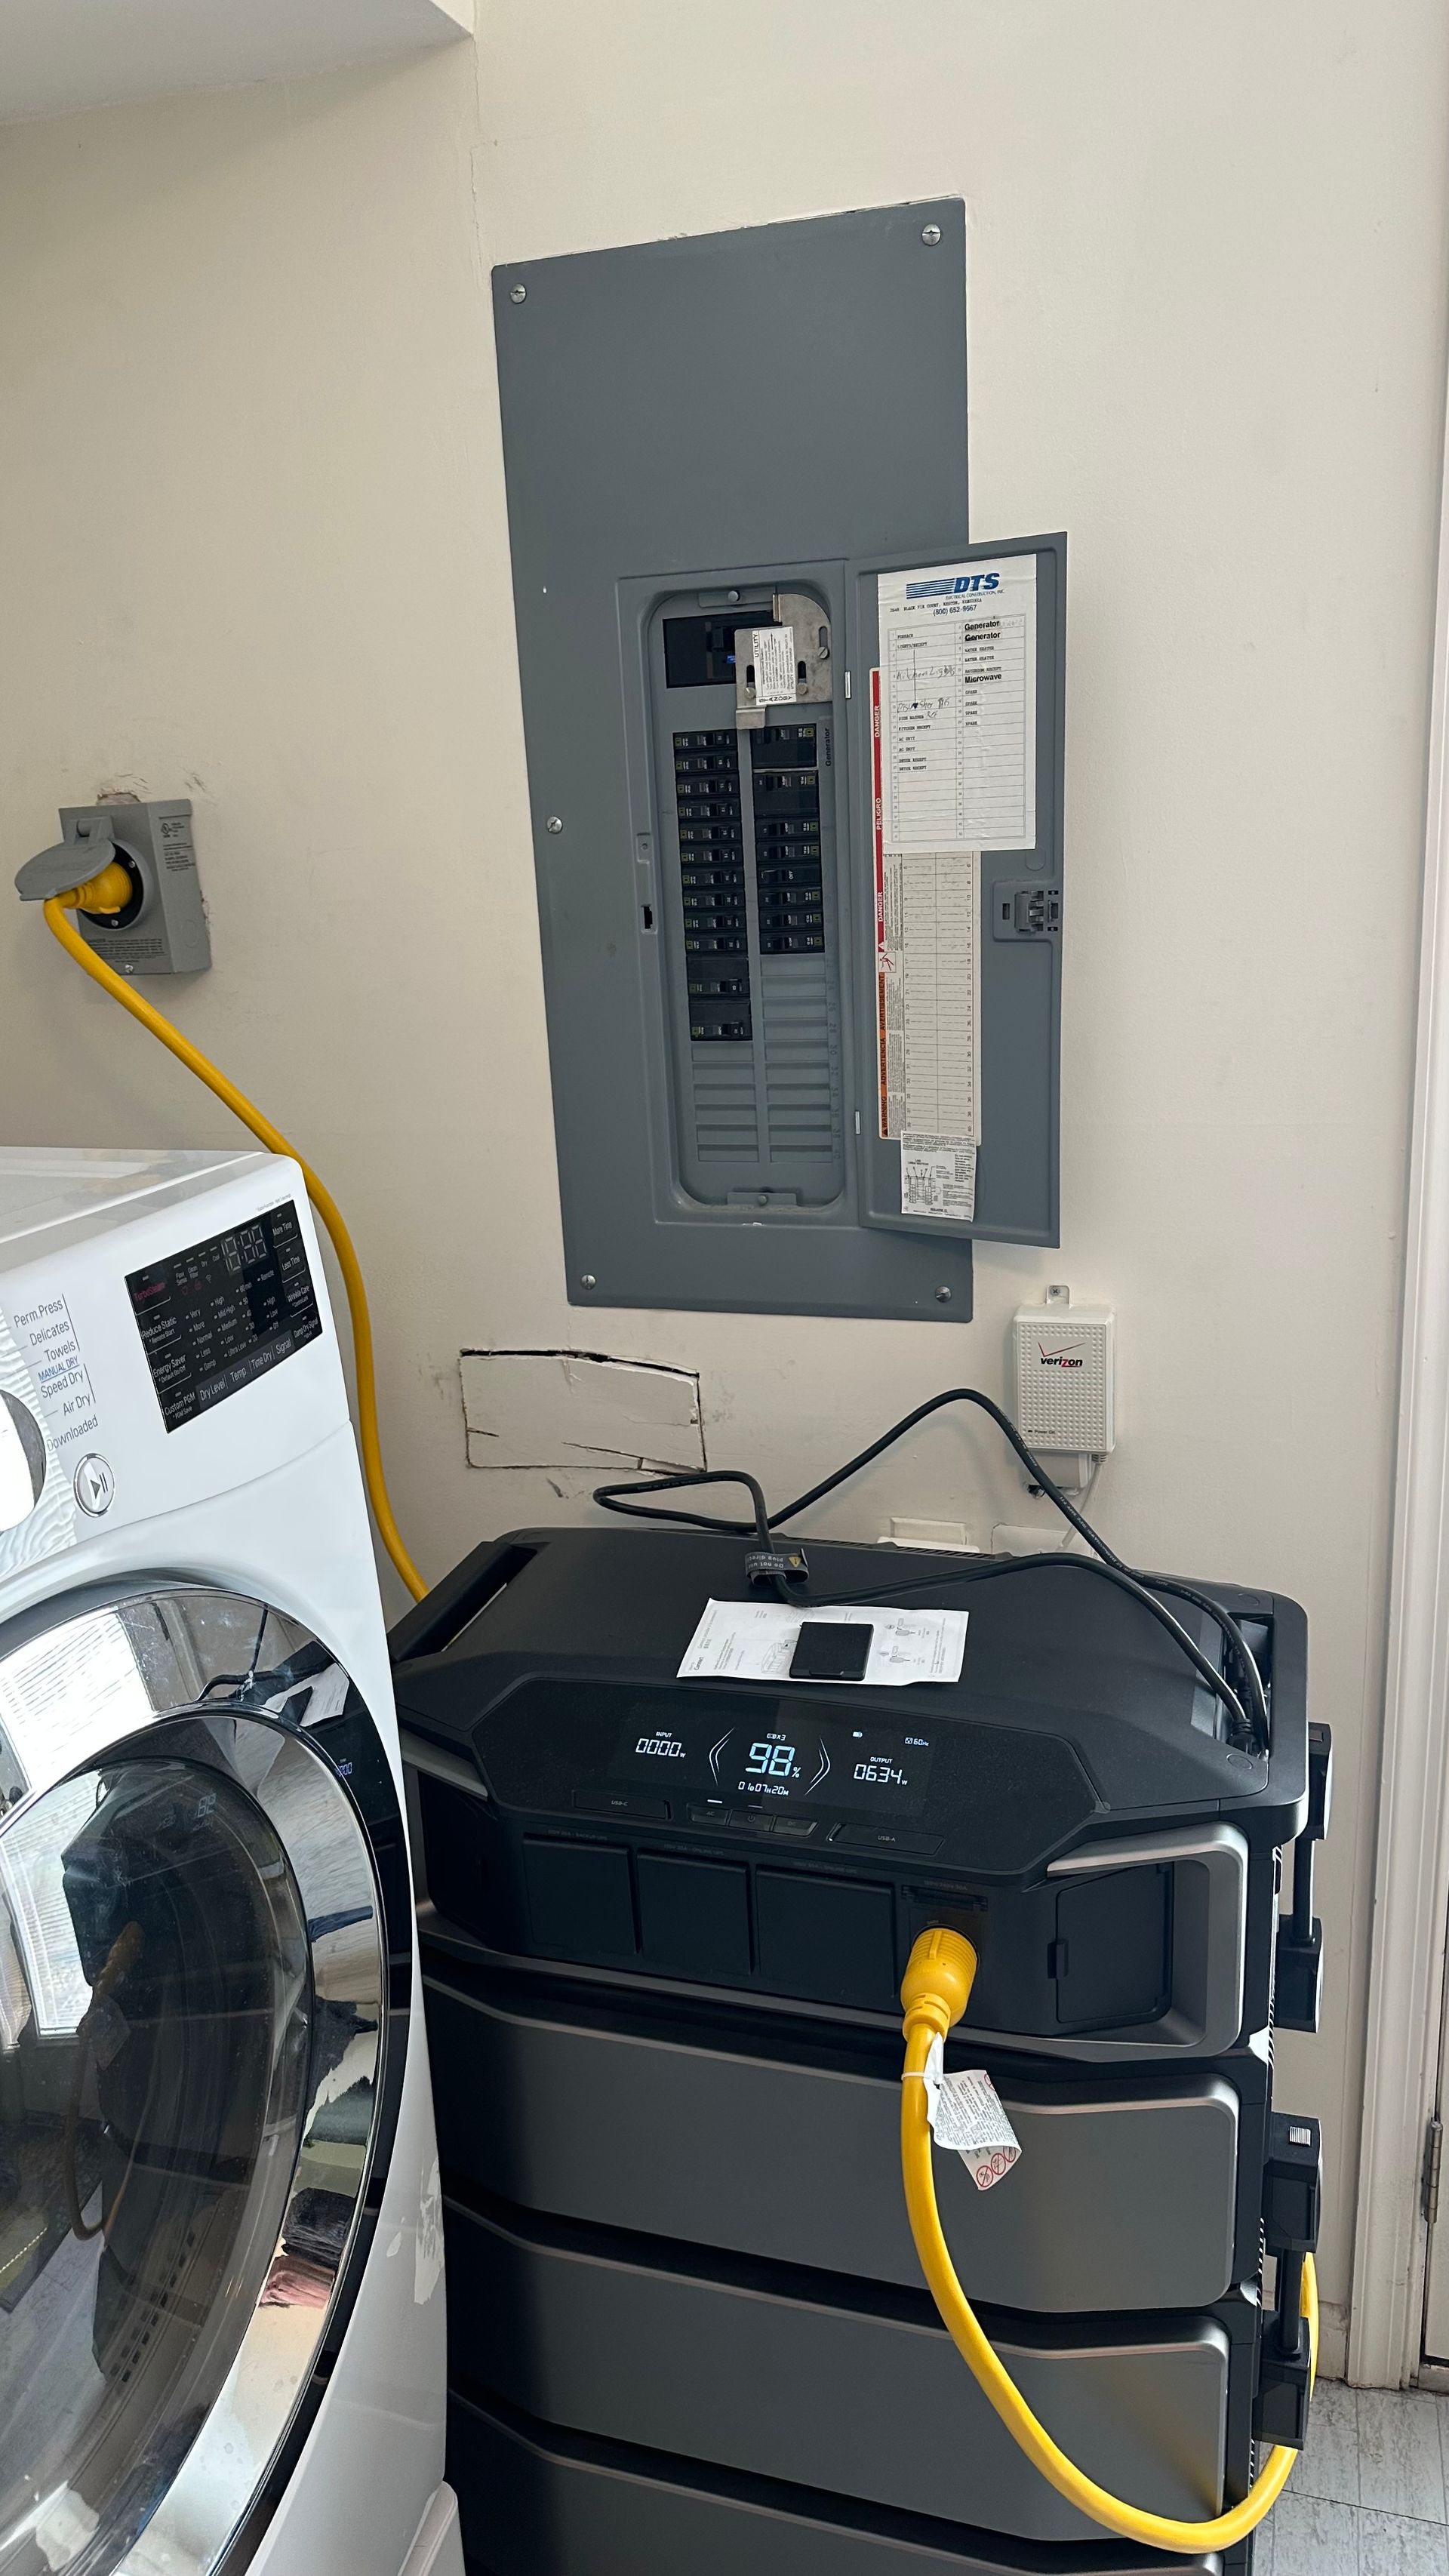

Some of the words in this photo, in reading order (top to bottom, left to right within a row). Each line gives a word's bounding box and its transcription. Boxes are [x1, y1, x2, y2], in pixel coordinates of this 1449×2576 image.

[954, 573, 1000, 593] DTS
[933, 608, 949, 617] (800)
[964, 620, 1000, 631] Generator
[965, 632, 1001, 642] Generator
[964, 673, 1002, 684] Microwave
[272, 1226, 284, 1236] More
[281, 1260, 291, 1271] Less
[214, 1296, 225, 1306] High
[189, 1309, 201, 1319] Very
[29, 1321, 69, 1346] Delicates
[141, 1325, 162, 1340] Reduce
[161, 1316, 177, 1330] Static
[193, 1322, 205, 1332] More
[196, 1331, 213, 1345] Normal
[224, 1334, 234, 1344] Low
[275, 1337, 292, 1355] Signal
[45, 1340, 75, 1362] Towels
[200, 1348, 211, 1358] Less
[152, 1362, 171, 1378] Energy
[171, 1355, 186, 1368] Saver
[251, 1356, 263, 1369] Time
[263, 1350, 272, 1363] Dry
[1040, 1356, 1083, 1368] verizon
[38, 1362, 66, 1381] MANUAL
[66, 1356, 78, 1368] DRY
[230, 1367, 247, 1383] Temp
[41, 1375, 68, 1399] Speed
[69, 1369, 84, 1386] Dry
[200, 1387, 211, 1401] Dry
[211, 1377, 226, 1395] Level
[63, 1401, 75, 1416] Air
[76, 1393, 91, 1409] Dry
[164, 1399, 184, 1416] Custom
[183, 1391, 195, 1405] PGM
[47, 1414, 98, 1451] Downloaded
